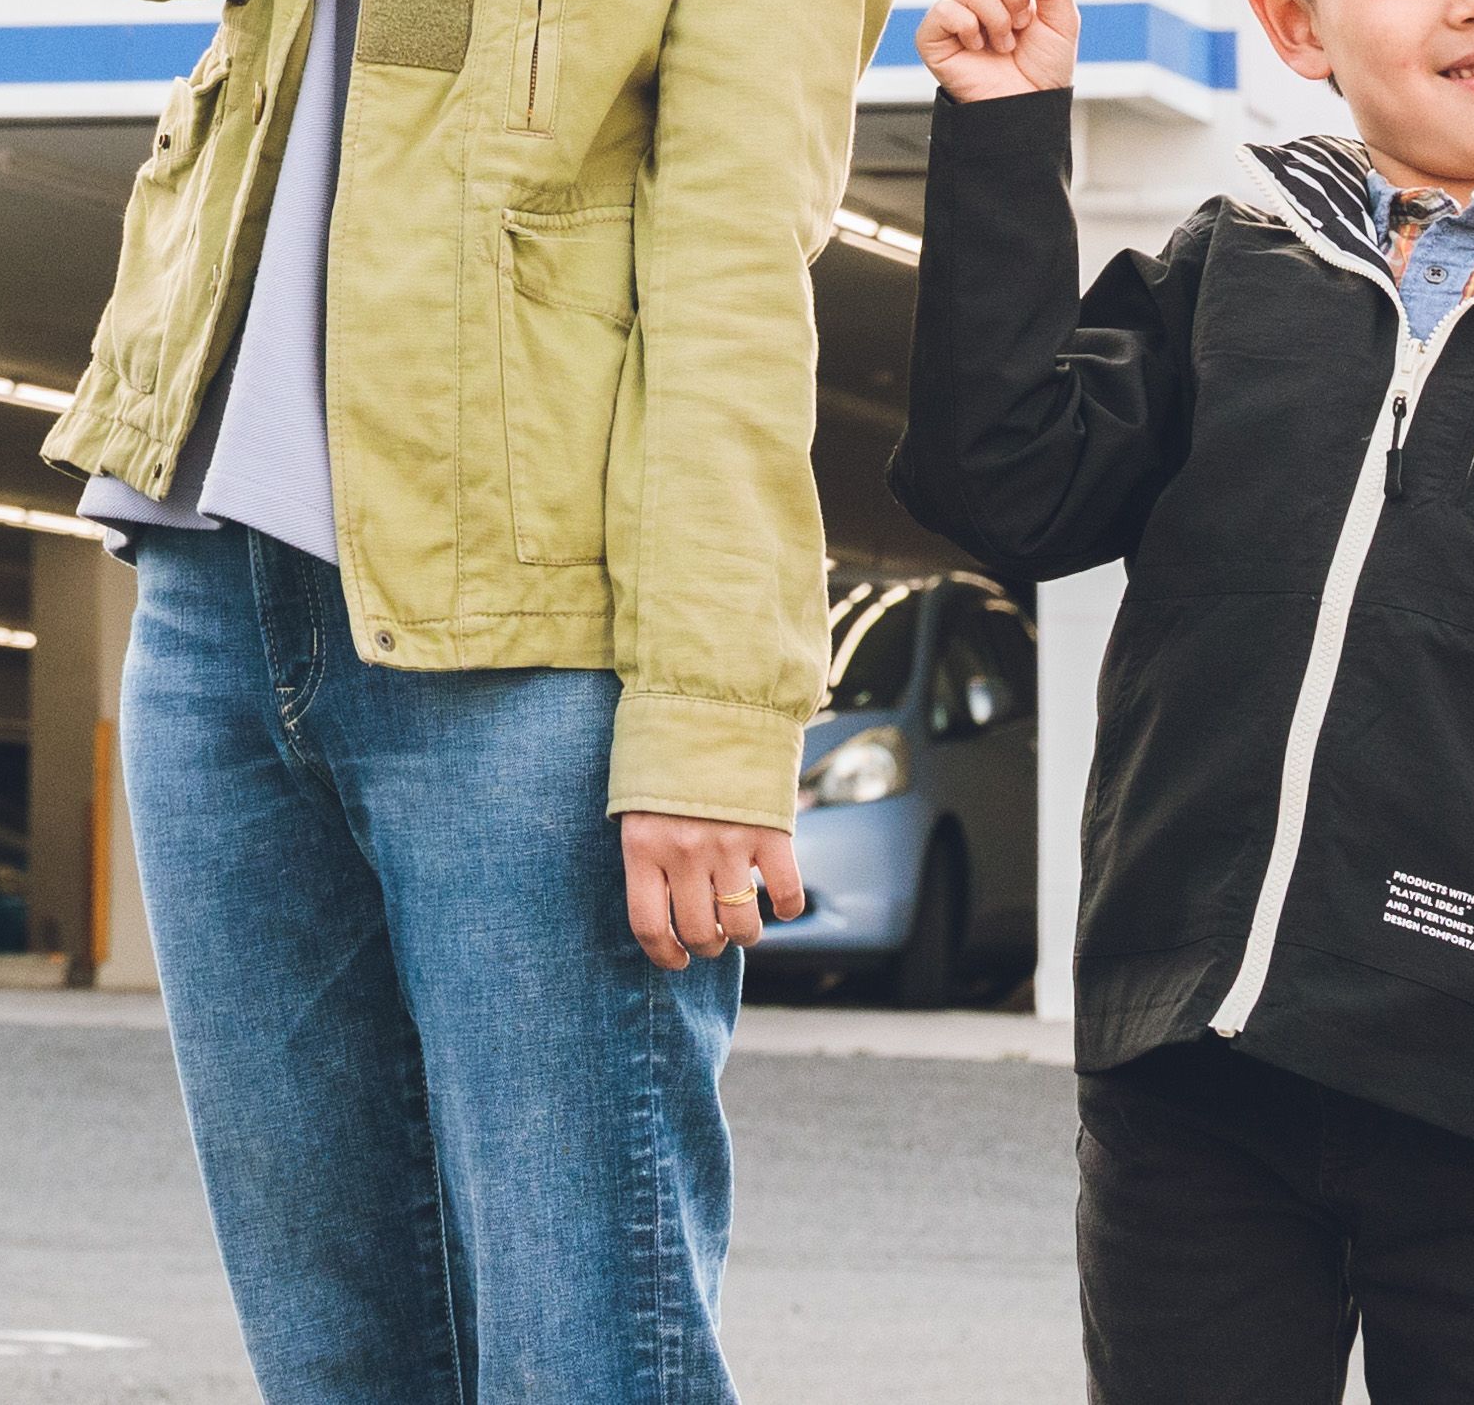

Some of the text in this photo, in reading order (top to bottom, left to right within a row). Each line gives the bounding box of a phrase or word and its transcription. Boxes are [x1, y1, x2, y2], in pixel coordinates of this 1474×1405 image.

[1393, 871, 1448, 895] PRODUCTS
[1383, 912, 1420, 932] DESIGN
[1413, 907, 1474, 935] EVERYONE'S
